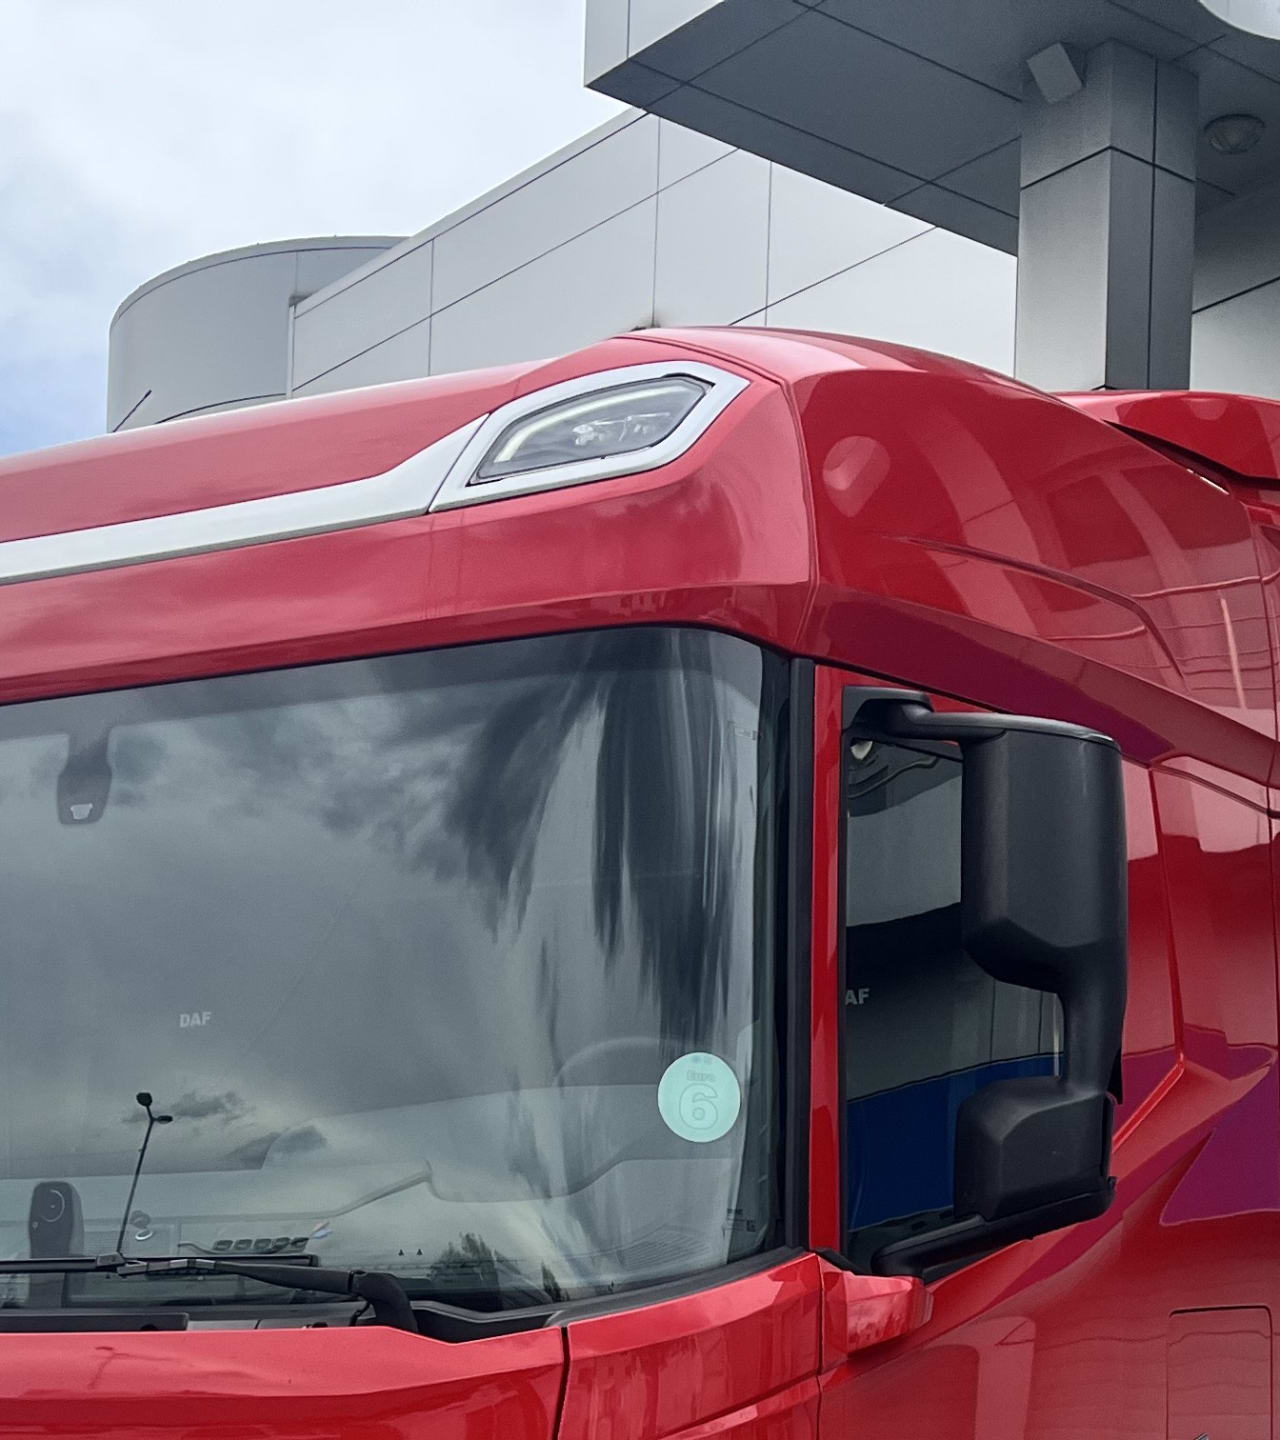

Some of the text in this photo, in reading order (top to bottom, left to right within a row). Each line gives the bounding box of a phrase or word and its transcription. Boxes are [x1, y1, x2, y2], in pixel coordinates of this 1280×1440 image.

[844, 988, 870, 1005] AF
[180, 1011, 212, 1028] DAF
[679, 1083, 718, 1130] 6
